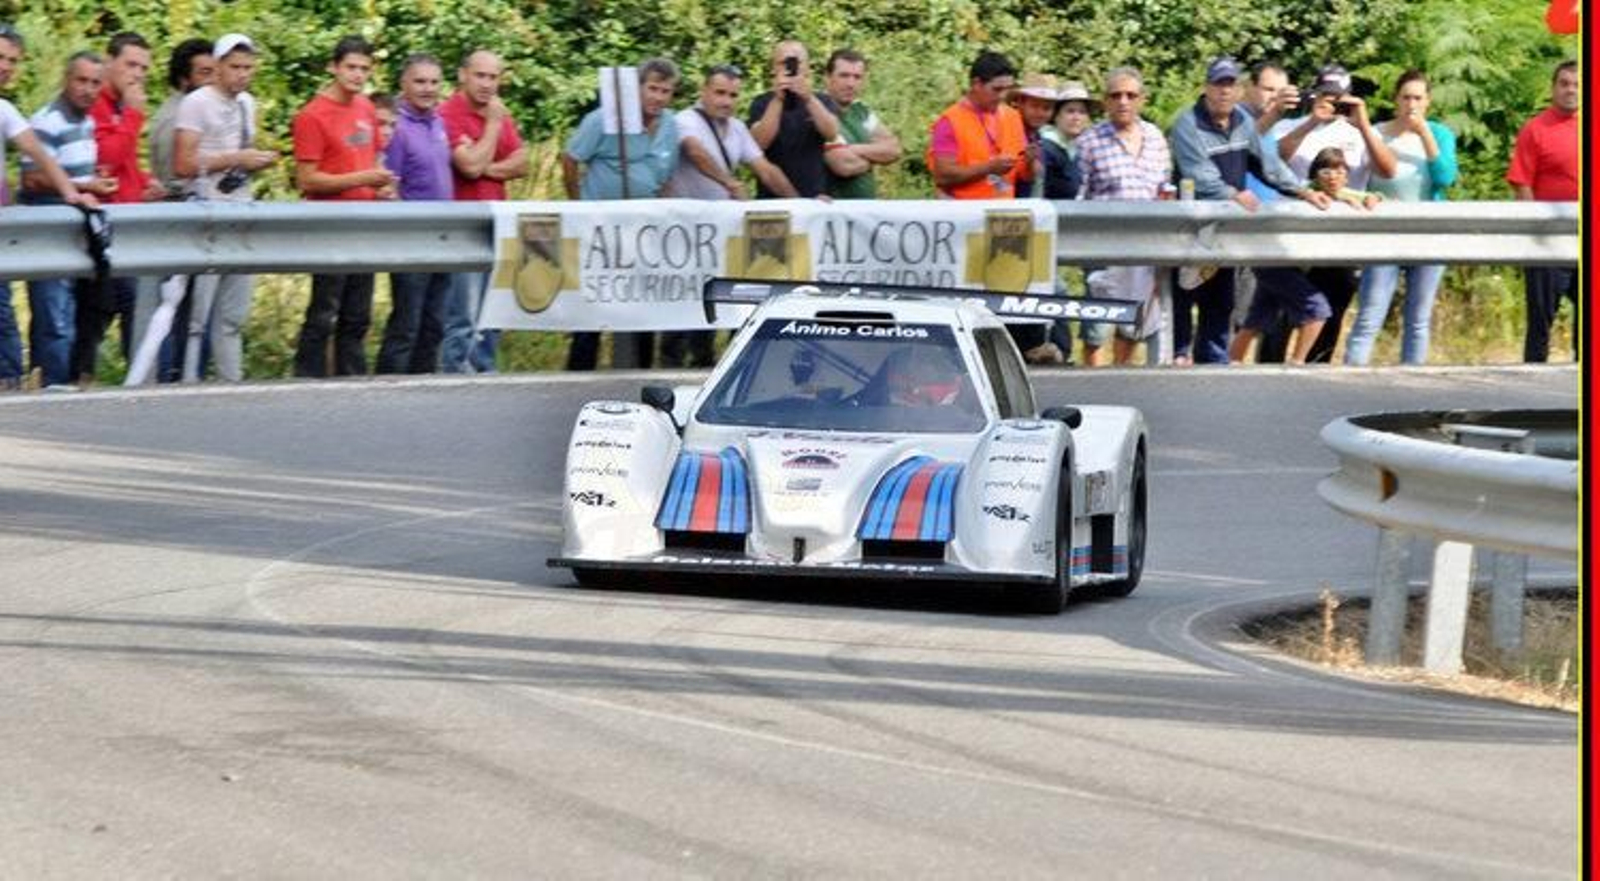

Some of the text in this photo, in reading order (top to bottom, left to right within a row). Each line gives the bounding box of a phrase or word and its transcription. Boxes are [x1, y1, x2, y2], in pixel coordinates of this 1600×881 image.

[584, 222, 718, 269] ALCOR
[818, 220, 956, 264] ALCOR
[581, 273, 711, 303] SEGURIDA
[1000, 295, 1127, 320] Motor
[780, 320, 929, 339] Ánimo Carlos
